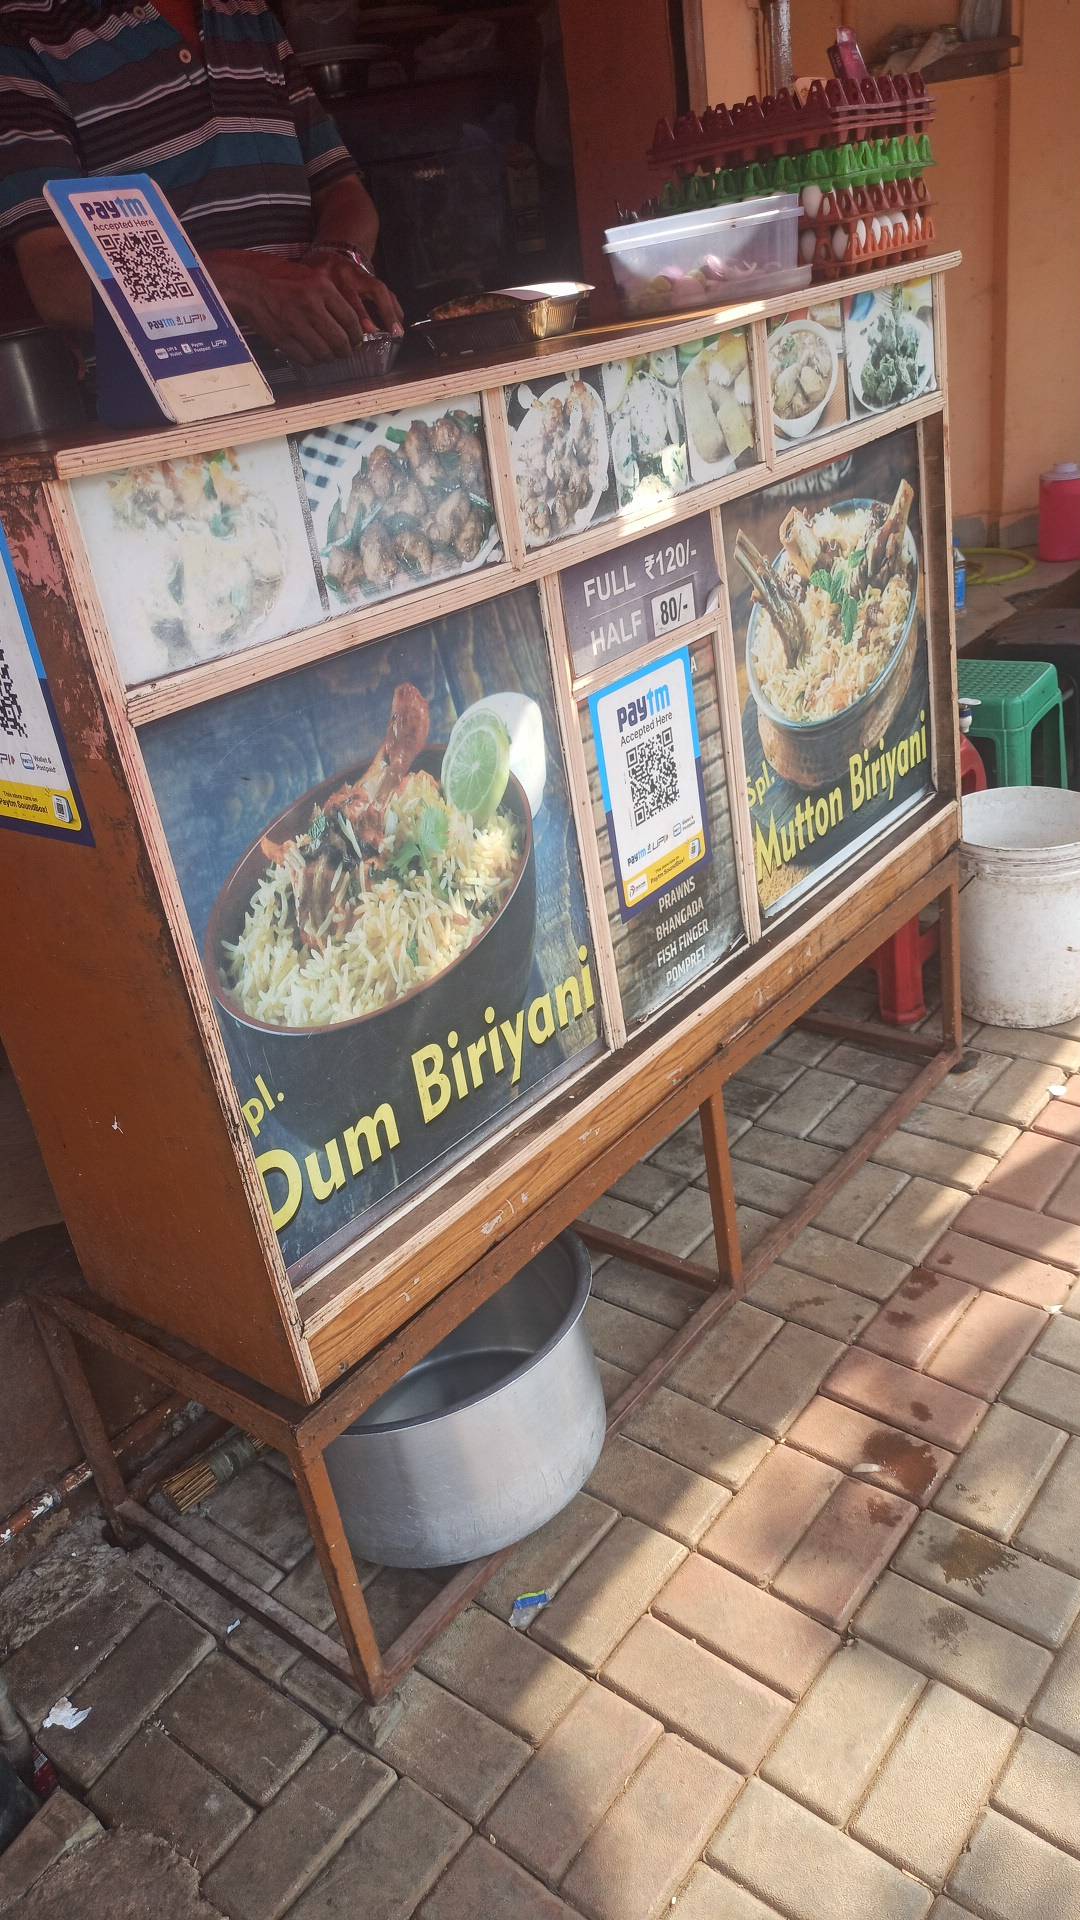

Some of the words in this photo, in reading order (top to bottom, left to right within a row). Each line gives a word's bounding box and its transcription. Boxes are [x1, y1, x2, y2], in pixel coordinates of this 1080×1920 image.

[93, 220, 133, 231] Accepted
[133, 219, 154, 227] Here
[583, 565, 636, 607] FULL
[644, 538, 697, 580] ₹120/-
[590, 609, 642, 656] HALF
[660, 593, 688, 625] 80/-
[620, 720, 655, 747] Accepted
[655, 711, 673, 727] Here
[746, 761, 775, 809] Spl.
[755, 786, 844, 883] Mutton
[848, 709, 928, 811] Biriyani
[658, 875, 696, 914] PRAWNS
[655, 896, 704, 942] BHANGADA
[656, 940, 678, 968] FISH
[678, 918, 710, 951] FINGER
[665, 944, 706, 986] POMPRET
[255, 1100, 402, 1233] Dum
[410, 944, 596, 1125] Biriyani
